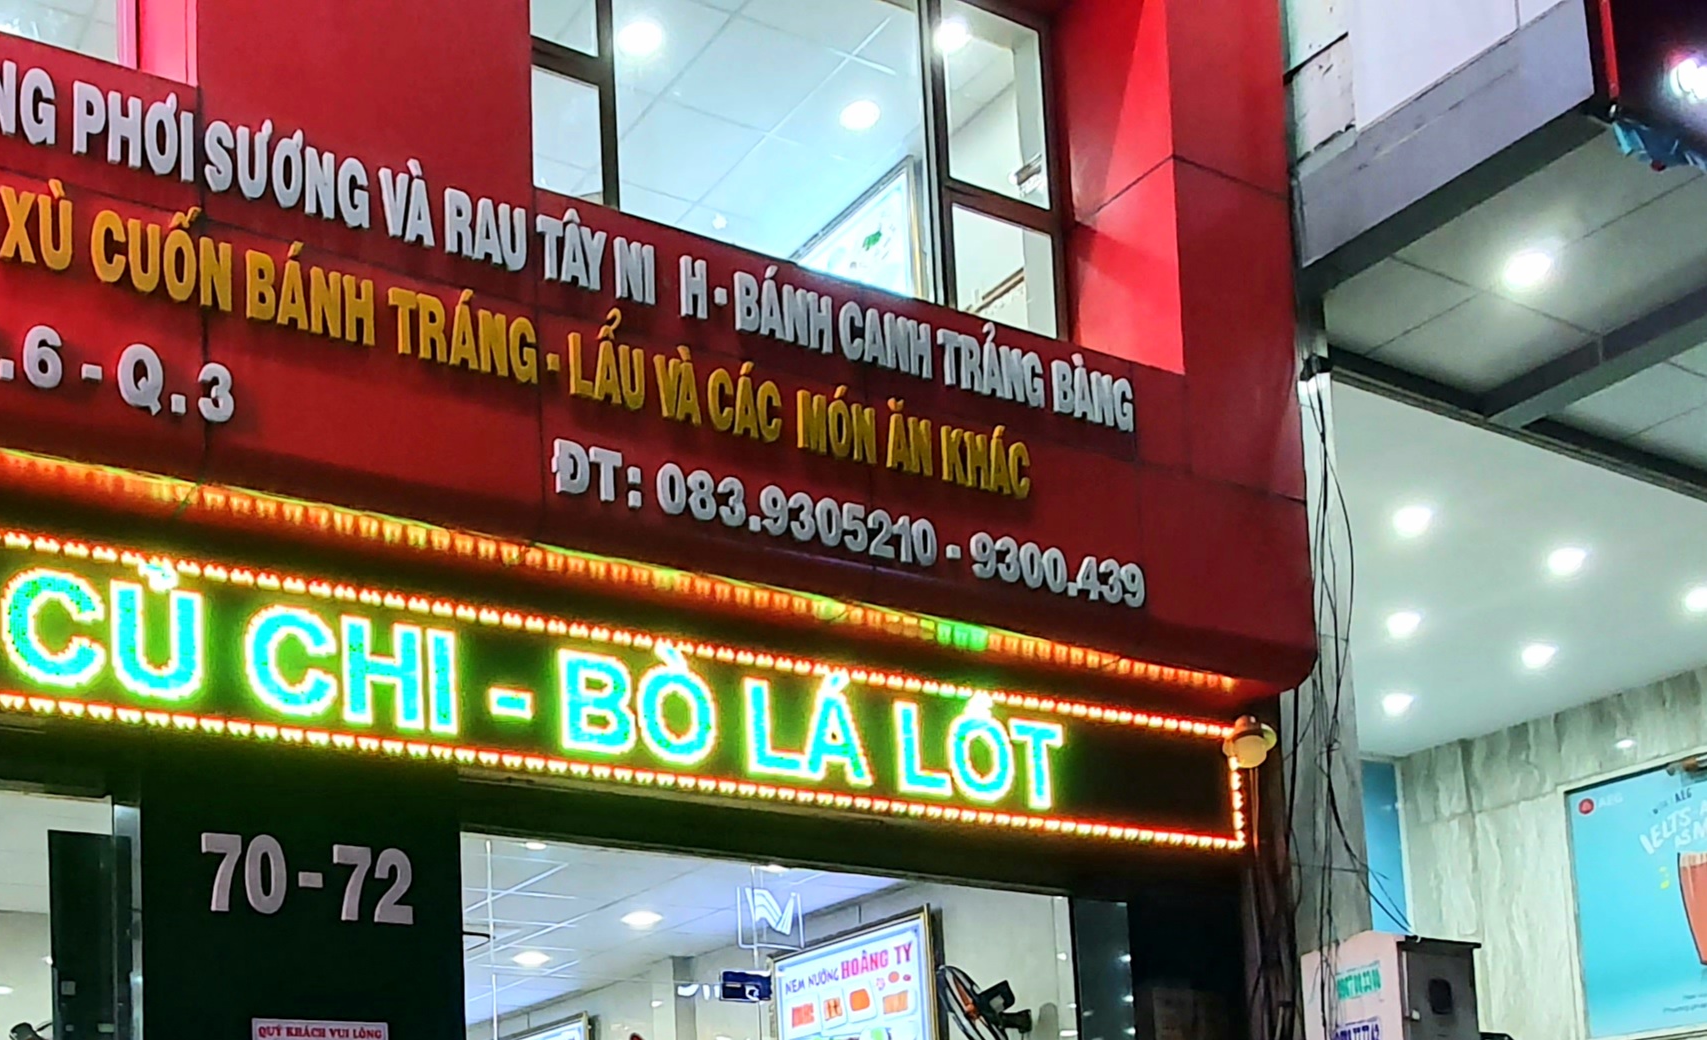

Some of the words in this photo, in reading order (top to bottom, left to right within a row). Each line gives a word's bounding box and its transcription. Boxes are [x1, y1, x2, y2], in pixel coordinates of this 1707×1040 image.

[73, 81, 194, 184] PHƠI
[204, 119, 370, 229] SƯƠNG
[379, 159, 435, 250] VÀ
[444, 187, 527, 272] RAU
[536, 209, 607, 290] TÂY
[733, 261, 833, 354] BÁNH
[838, 302, 932, 380] CANH
[936, 322, 1044, 411] TRẢNG
[1052, 353, 1135, 432] BÀNG
[0, 179, 73, 271] XÙ
[91, 206, 232, 312] CUỐN
[245, 242, 375, 345] BÁNH
[388, 288, 538, 384] TRÁNG
[566, 307, 644, 412] LẨU
[654, 345, 701, 425] VÀ
[707, 361, 782, 443] CÁC
[796, 385, 876, 466] MÓN
[886, 398, 932, 477] ĂN
[941, 425, 1031, 499] KHÁC
[116, 342, 235, 423] Q.3
[551, 437, 643, 509] ĐT:
[656, 462, 937, 568] 083.9305210
[969, 532, 1146, 609] 9300.439
[246, 603, 460, 737] CHI
[558, 642, 715, 762] BÒ
[743, 669, 873, 787] LÁ
[1639, 806, 1692, 855] IELTS
[893, 940, 914, 966] TY
[329, 1028, 350, 1038] VUI
